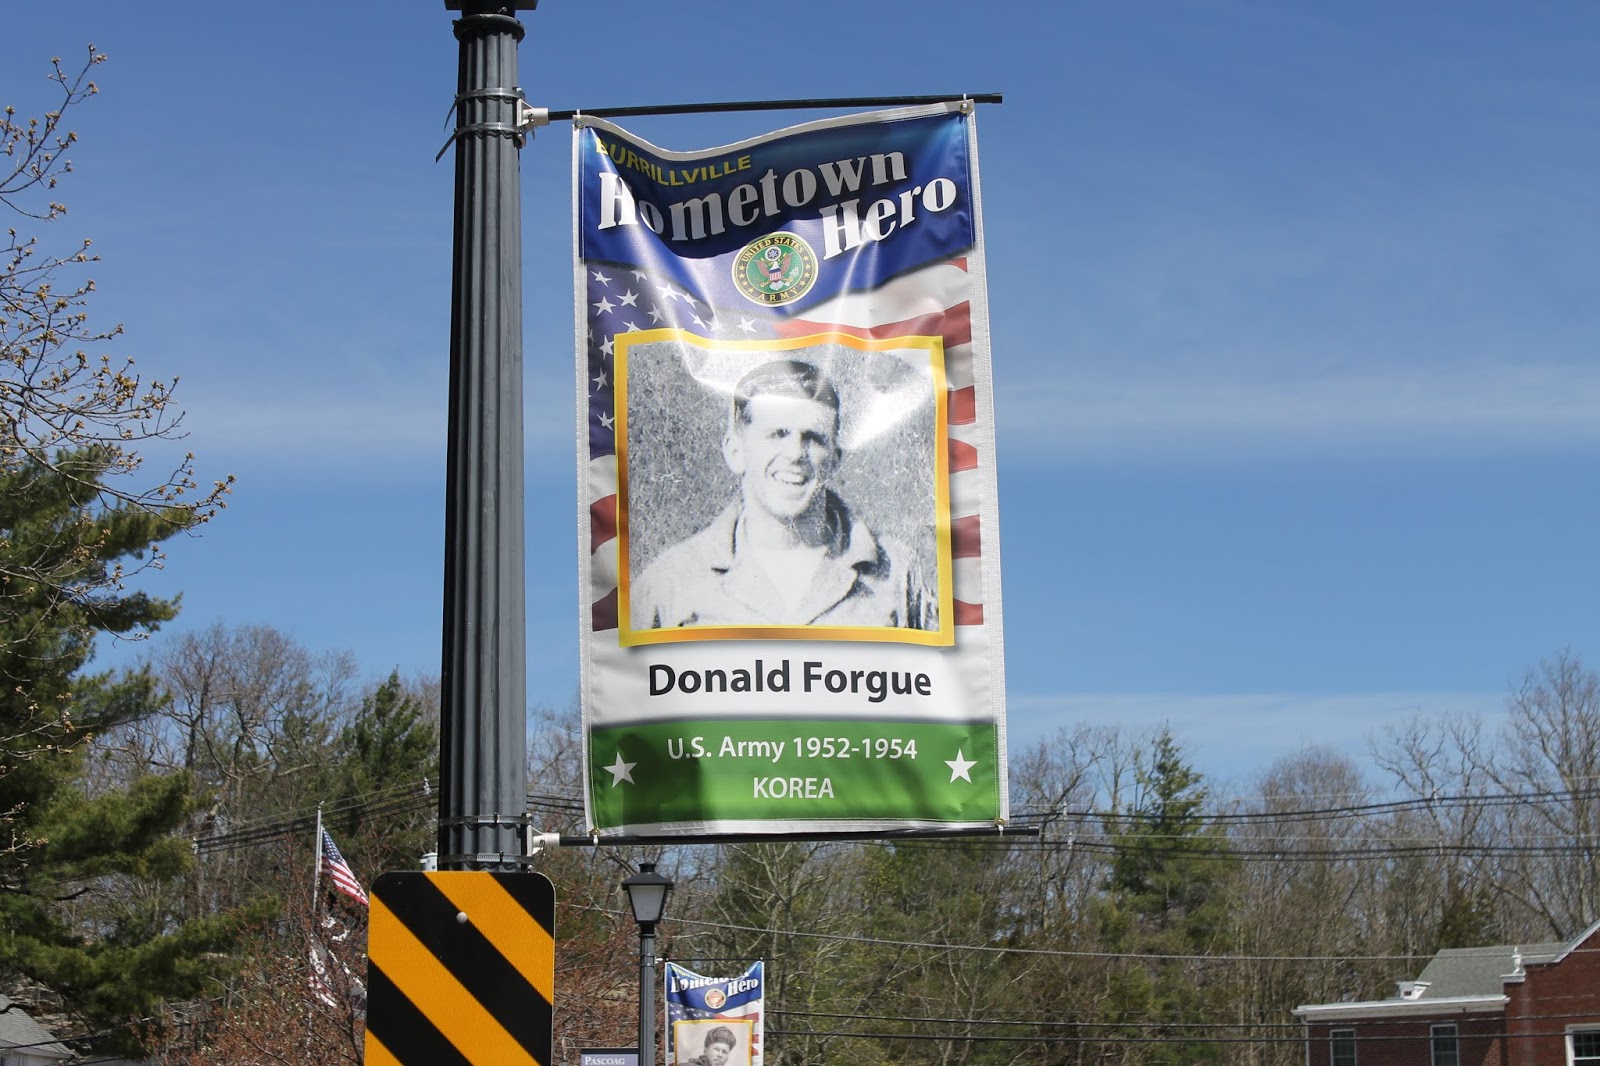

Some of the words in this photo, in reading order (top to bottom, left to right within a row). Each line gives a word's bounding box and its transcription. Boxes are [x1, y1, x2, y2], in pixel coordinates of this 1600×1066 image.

[596, 137, 752, 187] BURRILLVILLE
[597, 150, 907, 242] Hometown
[818, 178, 957, 261] Hero
[742, 238, 772, 262] UNITED
[773, 237, 805, 254] STATES
[758, 287, 798, 301] ARMY
[648, 660, 791, 697] Donald
[803, 661, 932, 703] Forgue
[667, 736, 712, 760] U.S.
[719, 736, 785, 763] Army
[793, 737, 918, 760] 1952-1954
[753, 777, 835, 799] KOREA
[727, 978, 760, 998] Hero
[584, 1056, 625, 1066] PASCOAG
